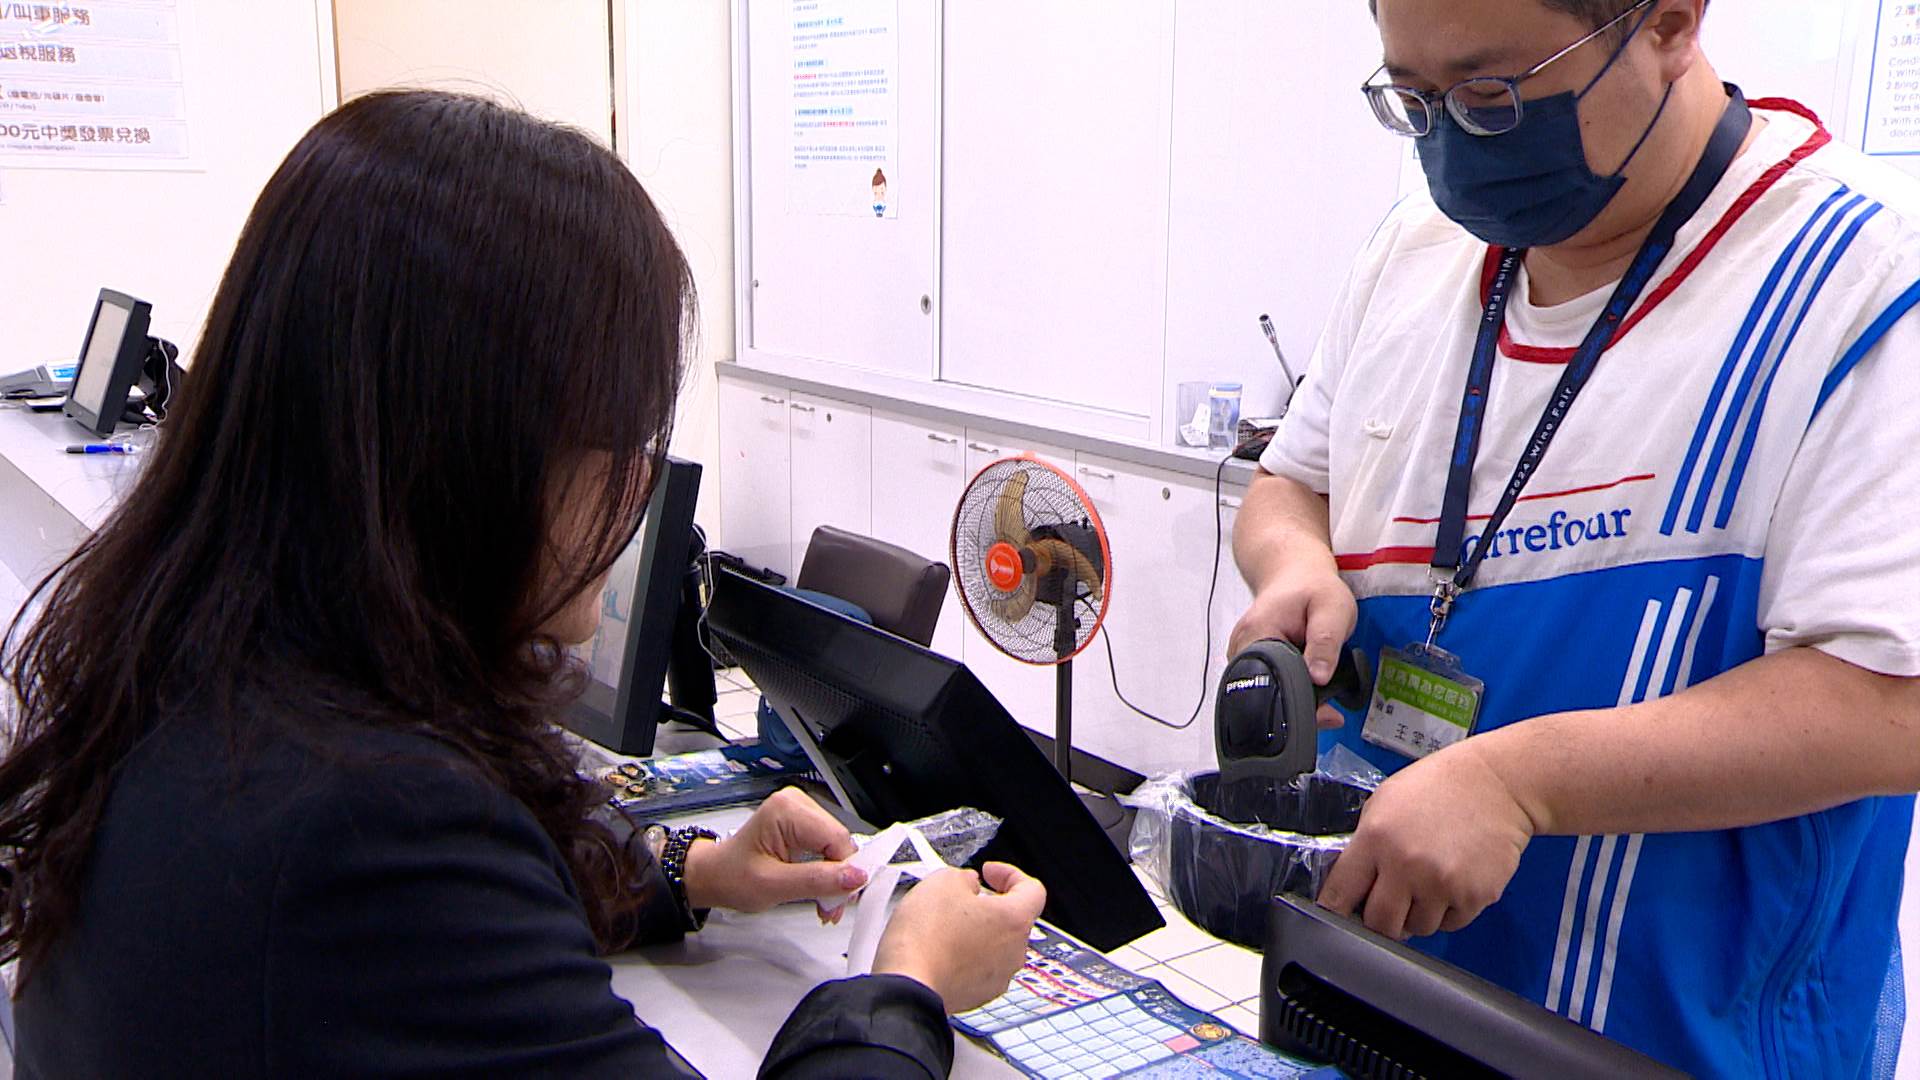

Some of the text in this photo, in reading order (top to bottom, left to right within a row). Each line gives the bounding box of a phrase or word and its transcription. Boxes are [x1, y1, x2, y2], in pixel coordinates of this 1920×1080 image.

[0, 3, 90, 26] /叫車服務
[1495, 257, 1513, 289] Wine
[1485, 295, 1501, 322] Fair
[1509, 387, 1572, 496] 2024 Wine Fair
